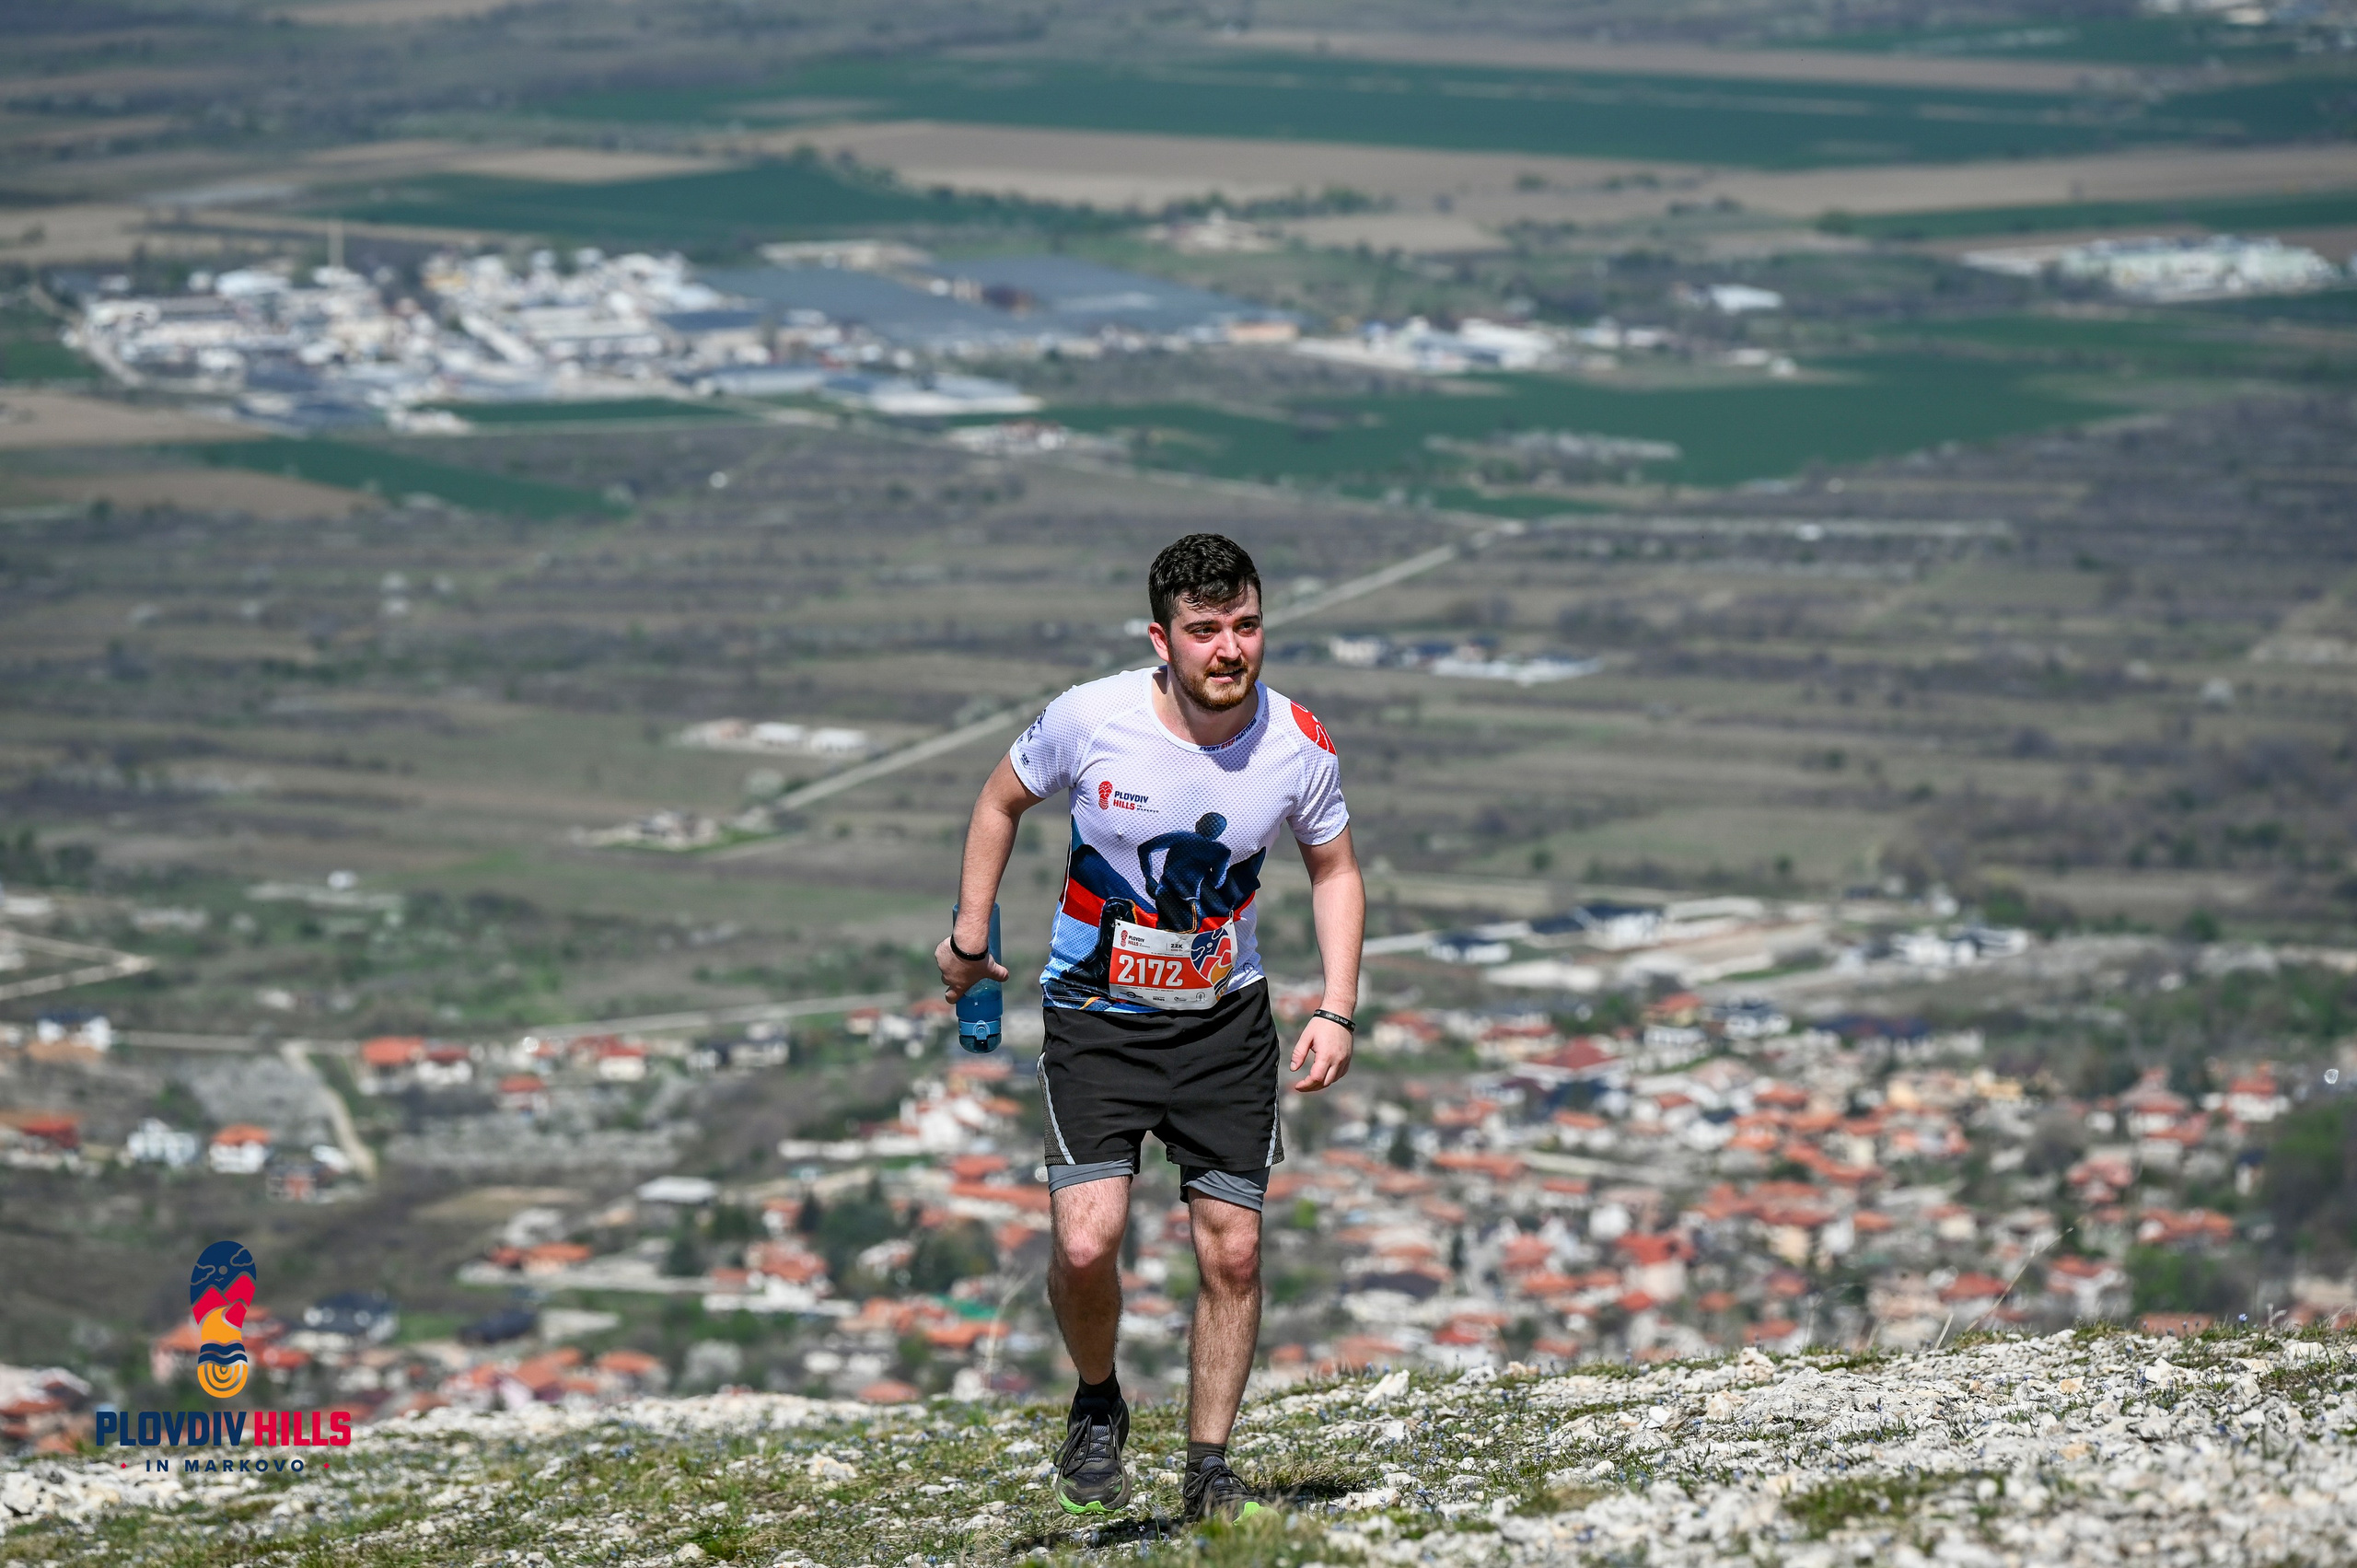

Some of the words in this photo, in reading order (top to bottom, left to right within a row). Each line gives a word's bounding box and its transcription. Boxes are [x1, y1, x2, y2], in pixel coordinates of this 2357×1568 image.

[1114, 790, 1149, 804] PLOVDIV
[1113, 798, 1136, 811] HILLS
[1128, 935, 1145, 943] PLOVDIV
[1117, 954, 1184, 987] 2172
